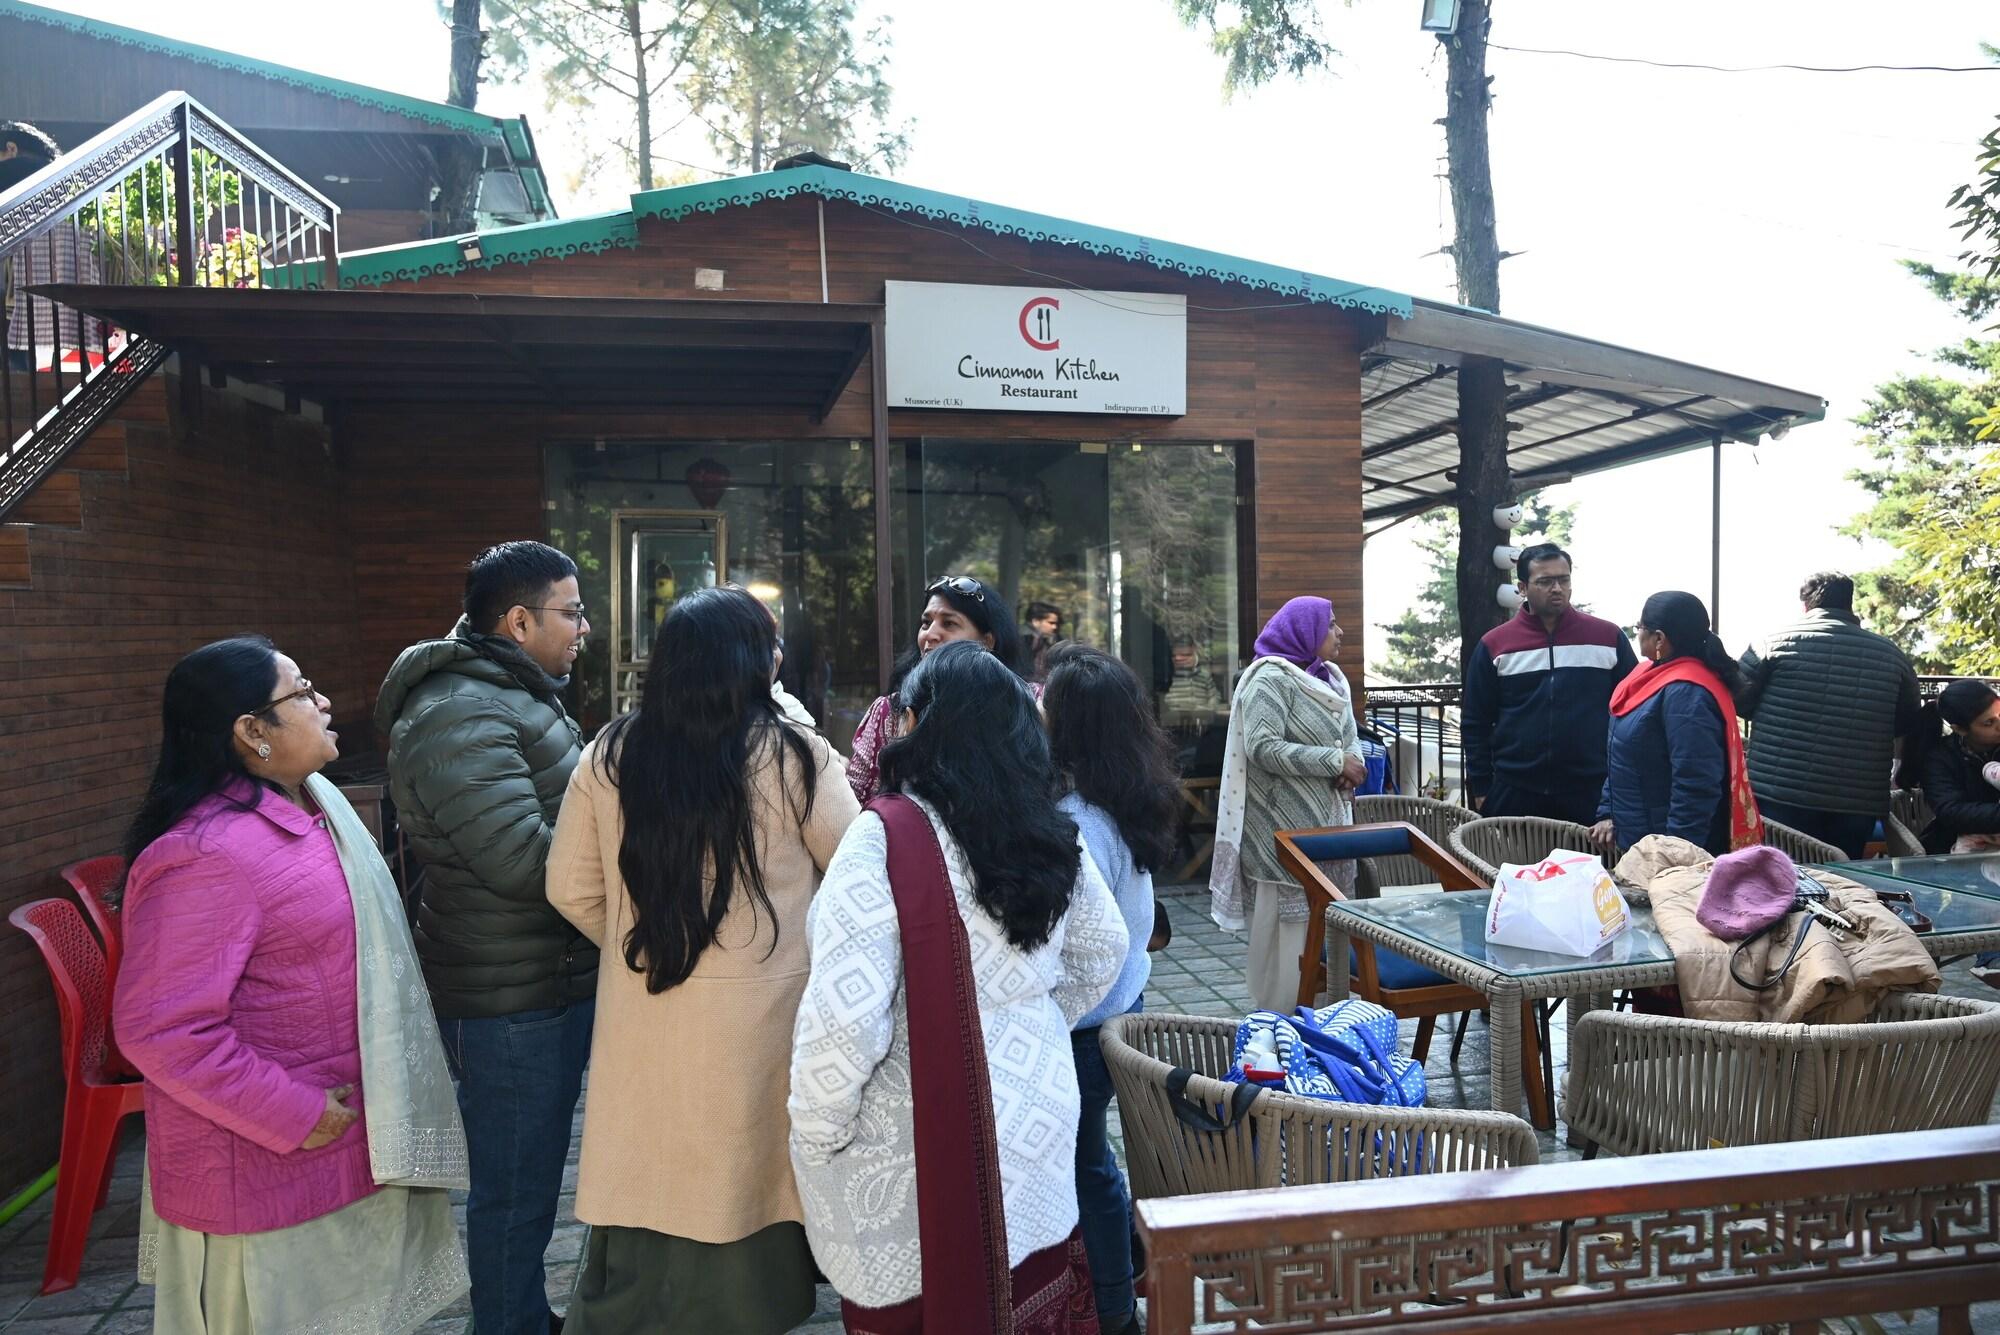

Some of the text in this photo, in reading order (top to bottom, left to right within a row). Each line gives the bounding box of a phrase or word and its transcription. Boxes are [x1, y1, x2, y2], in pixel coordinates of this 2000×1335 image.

[957, 354, 1120, 382] Cinnamon Kitchen
[1000, 383, 1078, 400] Restaurant
[904, 397, 941, 406] Mussoorie
[1104, 403, 1149, 413] Indirapuram
